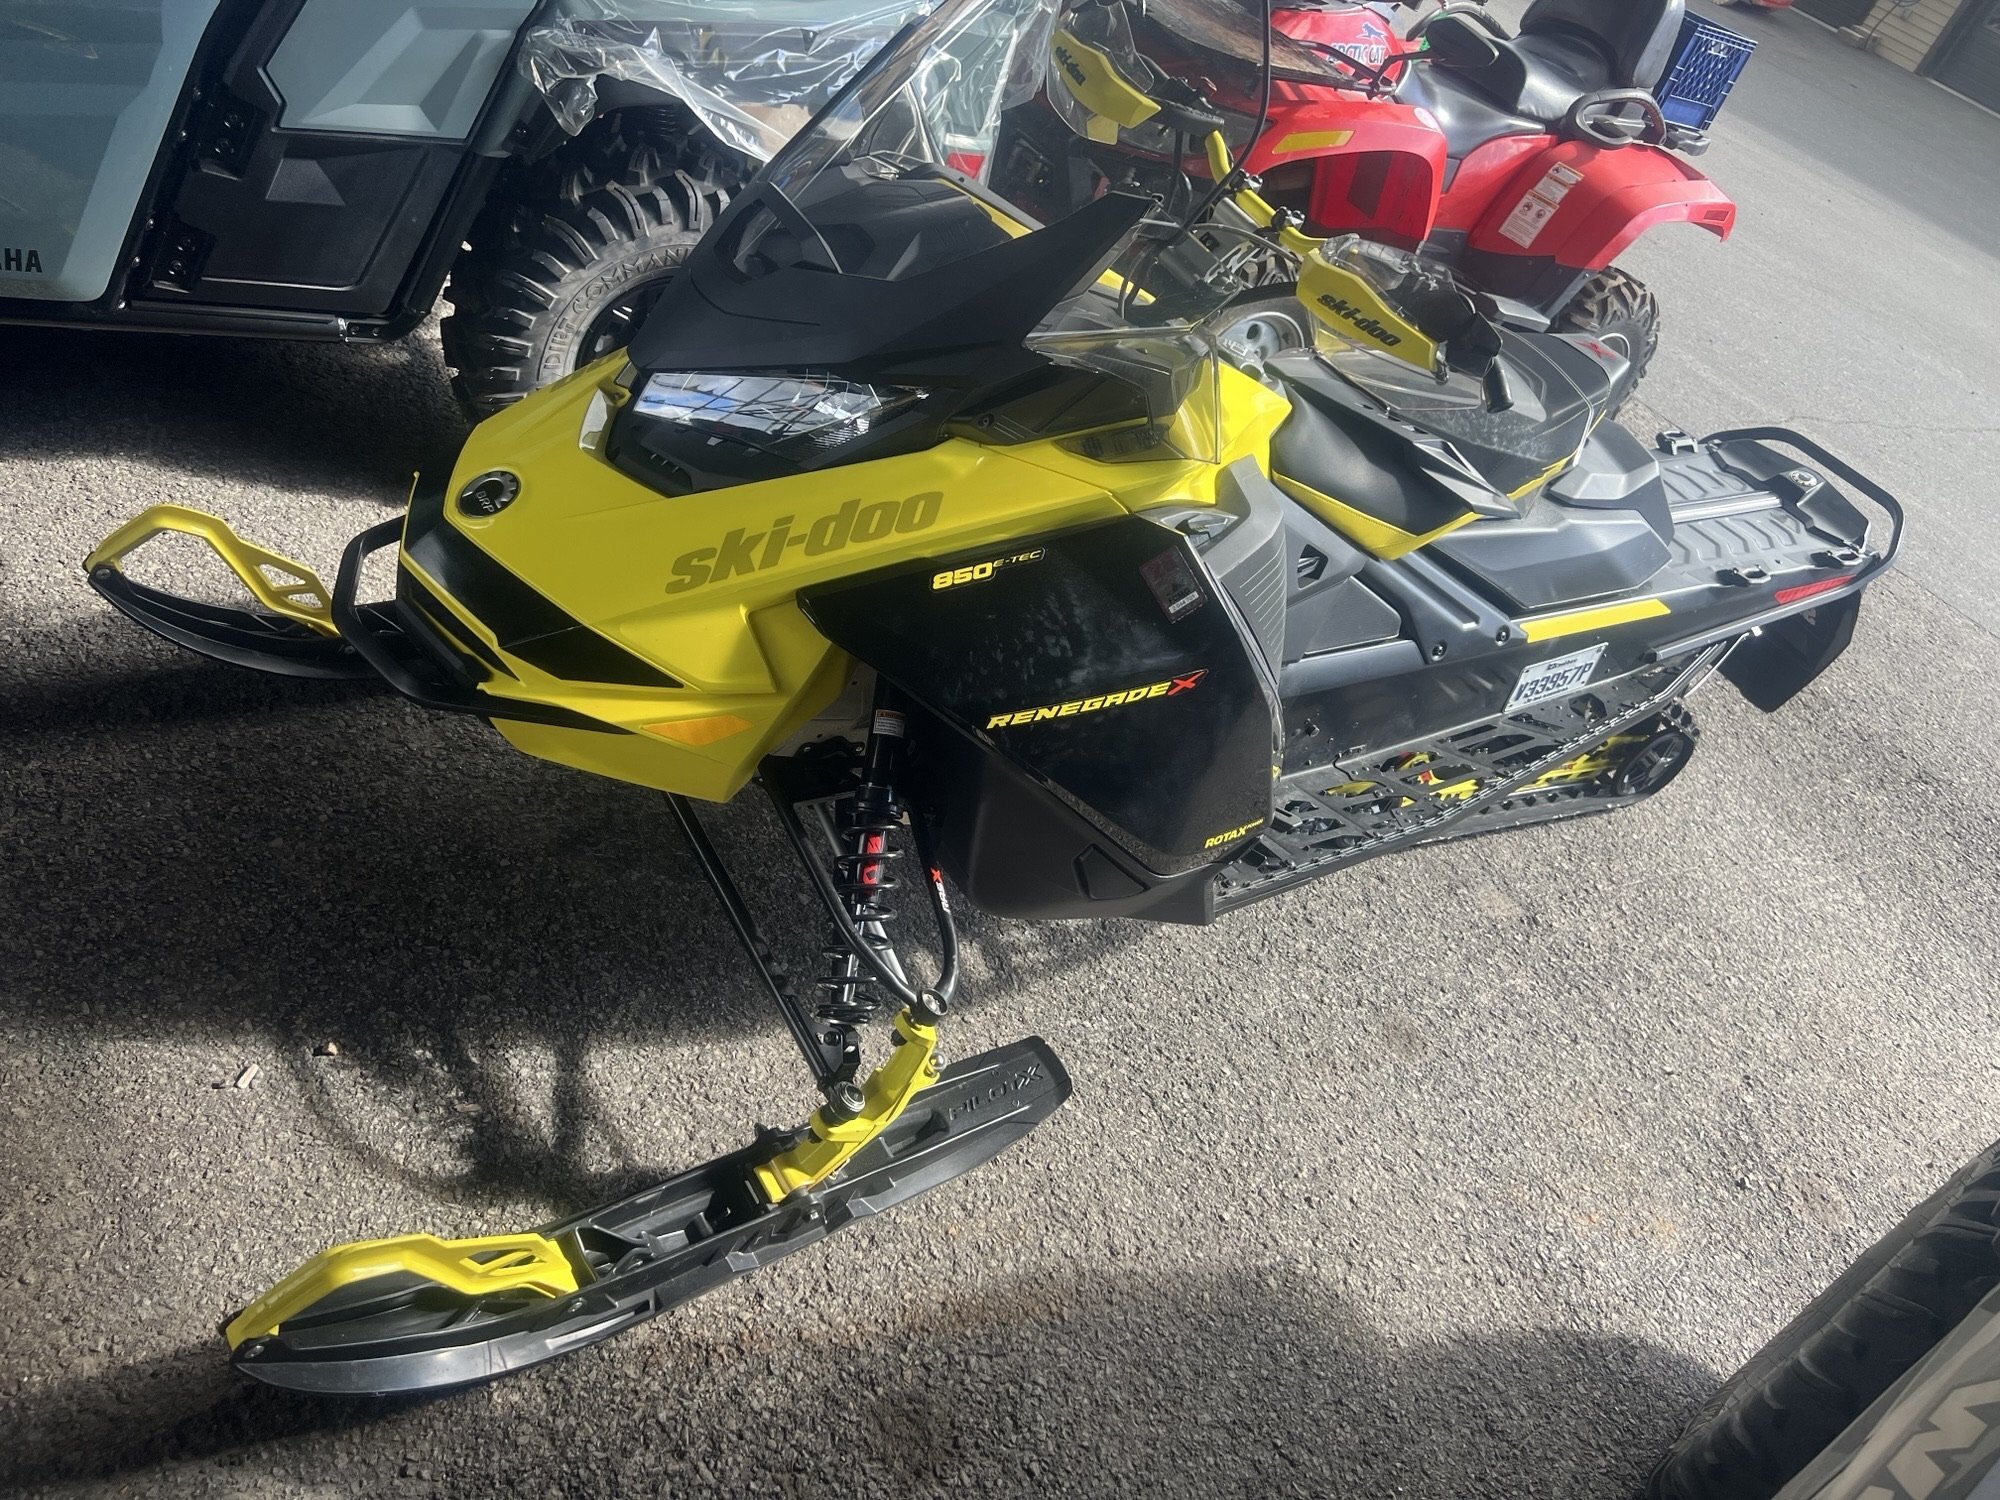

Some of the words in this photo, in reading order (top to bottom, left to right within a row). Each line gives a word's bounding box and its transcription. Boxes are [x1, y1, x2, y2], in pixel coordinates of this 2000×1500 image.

[1316, 294, 1402, 347] ski-doo
[476, 490, 495, 513] BRP
[664, 491, 945, 595] ski-doo
[932, 561, 993, 590] 850
[992, 549, 1042, 568] E-TEC
[1204, 825, 1247, 849] ROTAX
